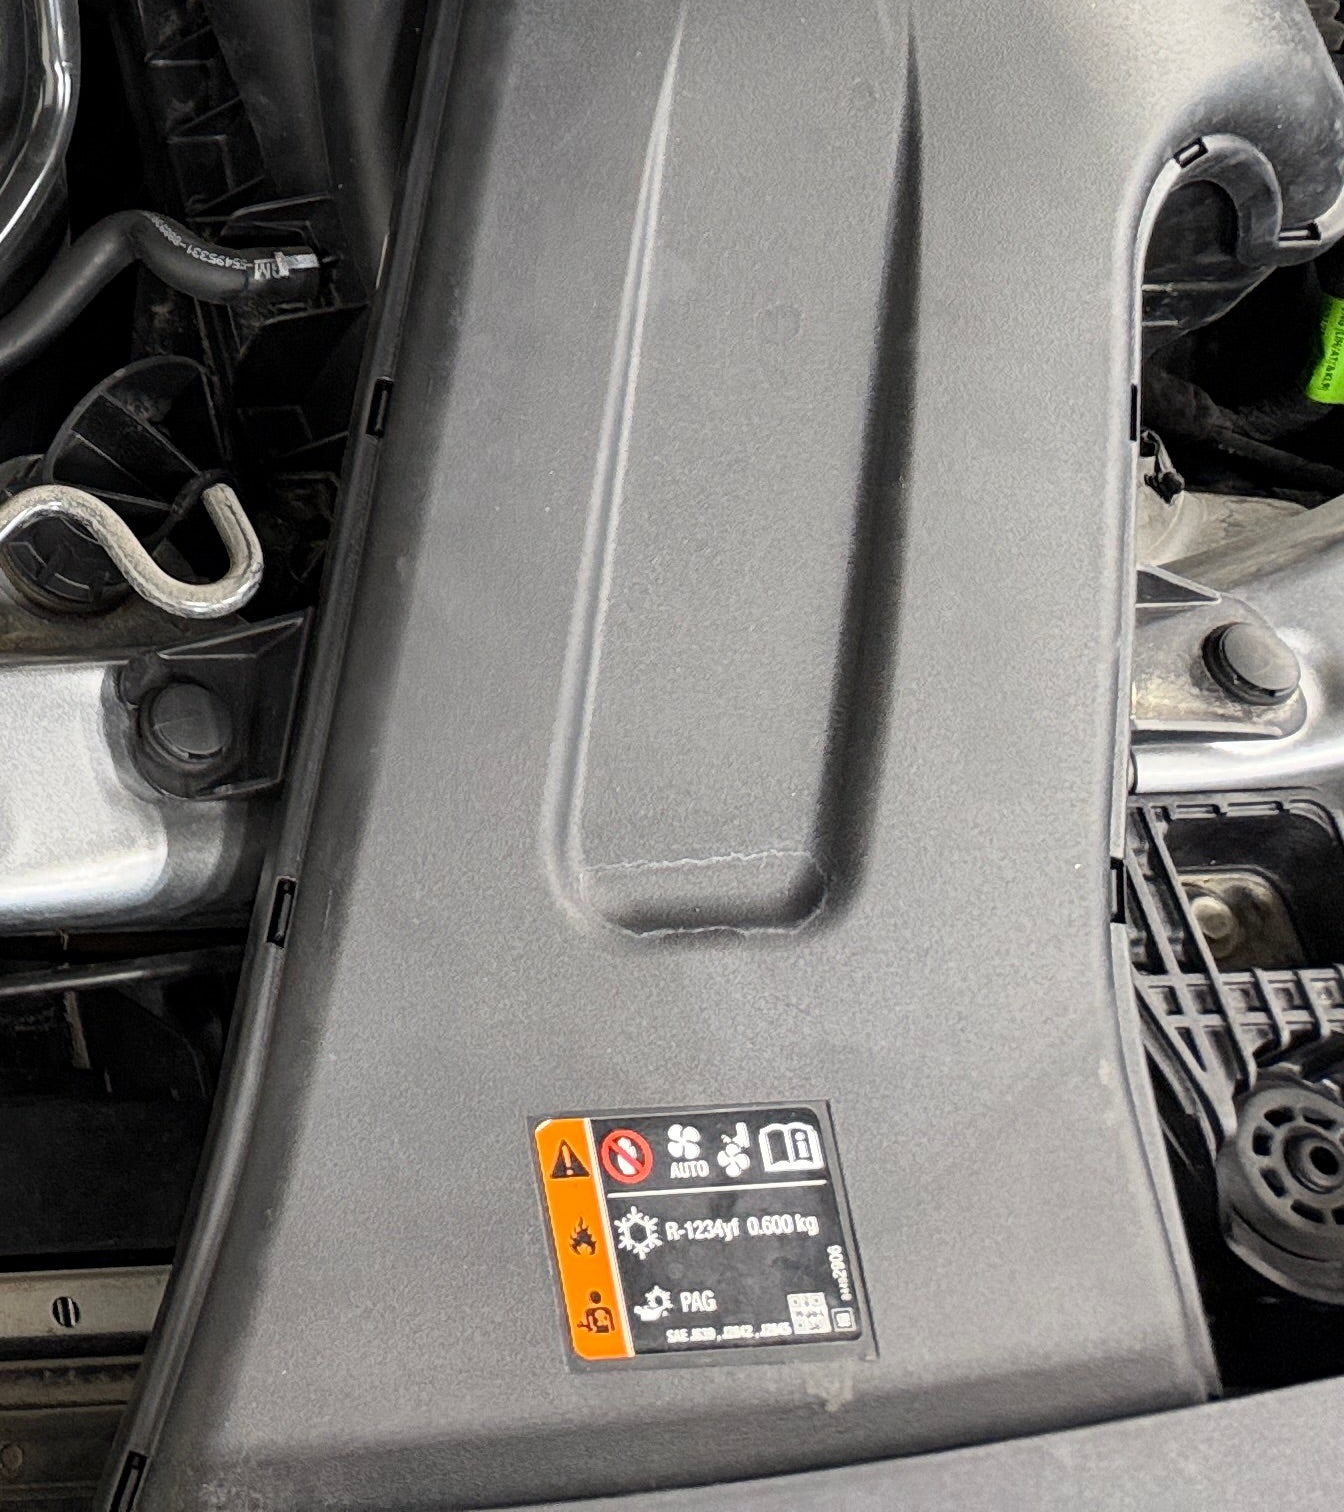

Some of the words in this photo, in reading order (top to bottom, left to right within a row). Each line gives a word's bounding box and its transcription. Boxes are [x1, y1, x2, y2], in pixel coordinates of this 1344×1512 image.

[670, 1160, 709, 1179] AUTO
[665, 1217, 740, 1241] R-1234yf
[746, 1215, 794, 1236] 0.600
[795, 1213, 819, 1236] kg
[679, 1290, 717, 1312] PAG
